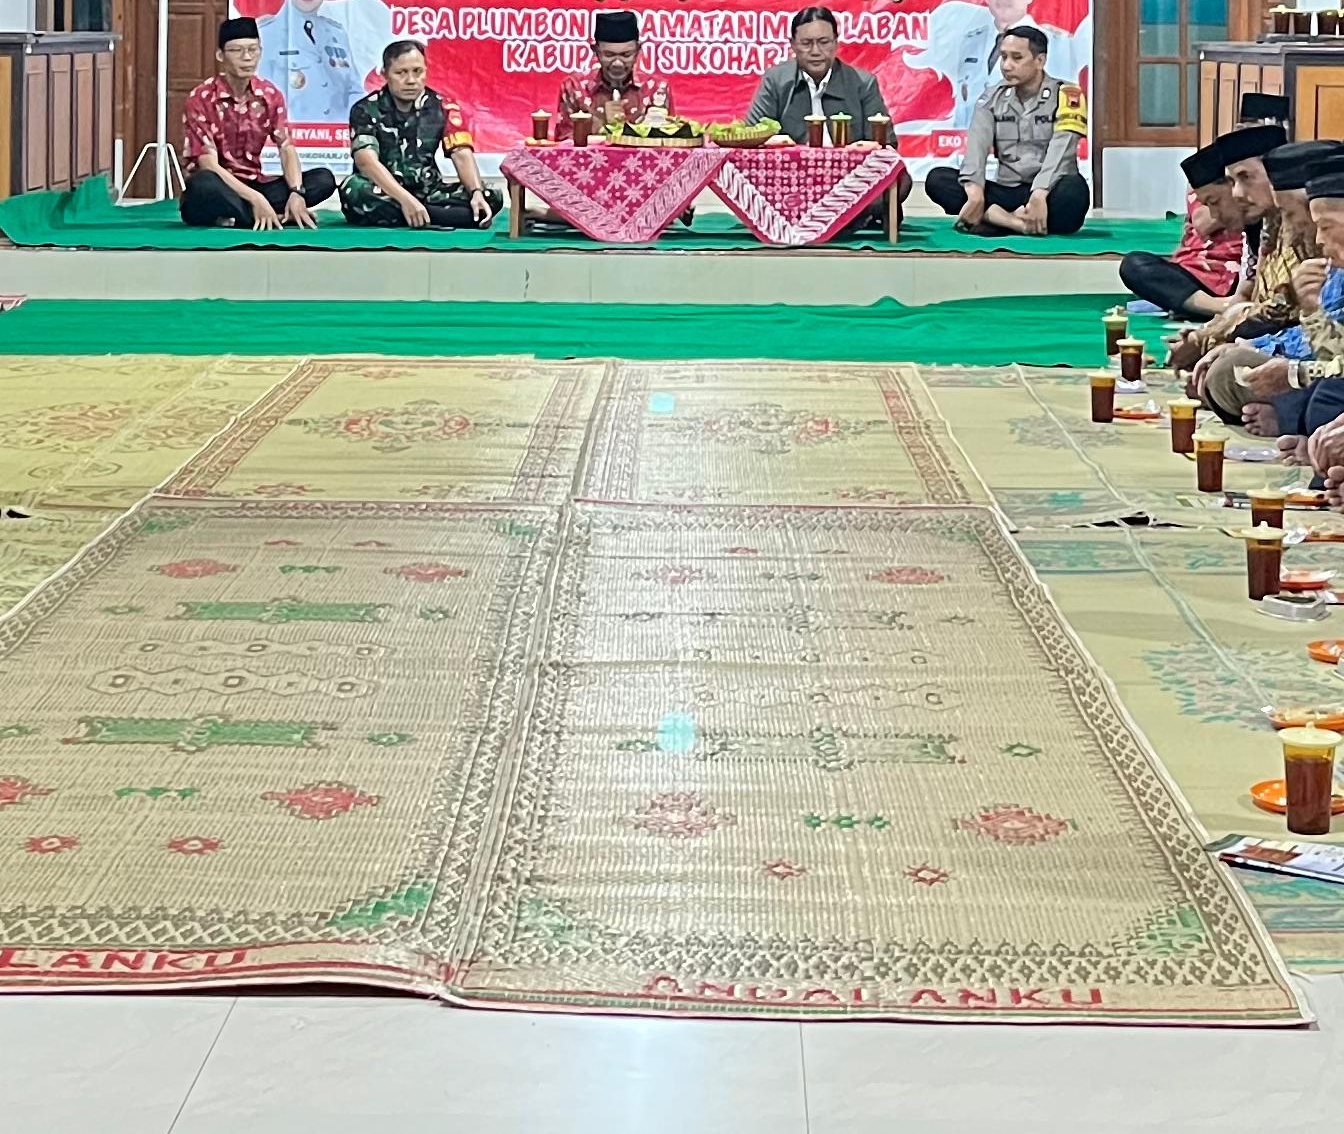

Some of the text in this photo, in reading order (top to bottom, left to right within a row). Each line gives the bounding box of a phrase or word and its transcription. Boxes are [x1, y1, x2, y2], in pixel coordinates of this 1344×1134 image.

[391, 7, 929, 44] DESA PLUMBON AMATAN MLABAN
[504, 41, 796, 75] KABUPN SUKOHAR
[938, 135, 962, 147] EKO
